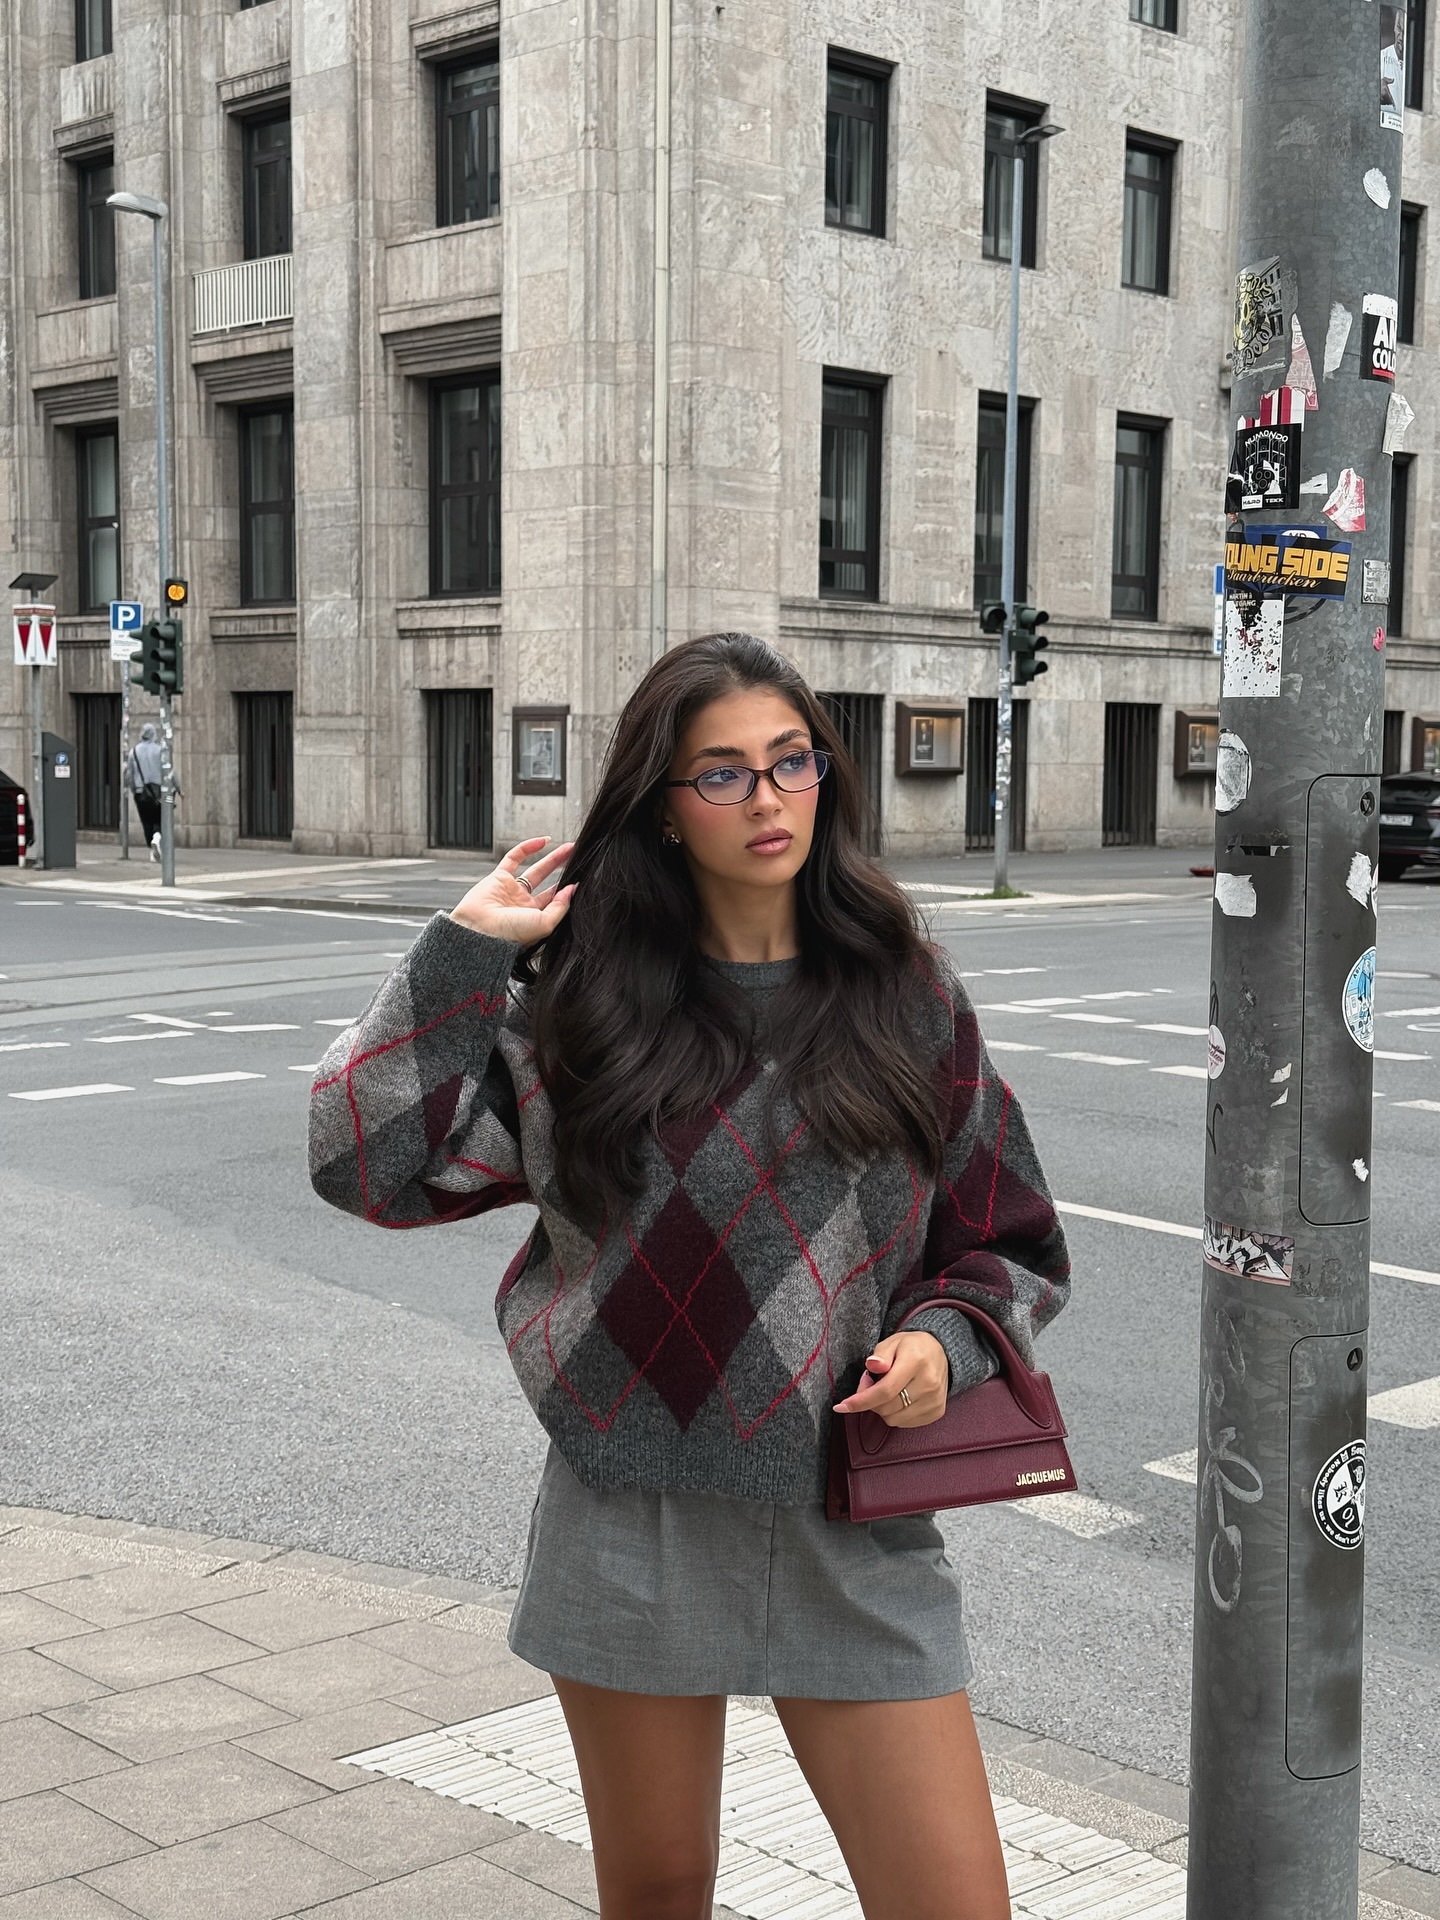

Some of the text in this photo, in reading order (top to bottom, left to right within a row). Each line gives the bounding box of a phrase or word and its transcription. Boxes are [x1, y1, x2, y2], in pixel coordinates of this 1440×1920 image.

[1244, 430, 1289, 447] NUMONDO
[1225, 542, 1280, 574] OUNG
[1281, 547, 1350, 582] SIDE
[1228, 564, 1321, 588] Saarbrücken
[117, 605, 136, 630] P
[1015, 1468, 1066, 1487] JACQUEMUS
[1319, 1458, 1341, 1487] Nobody
[1317, 1489, 1325, 1510] likes
